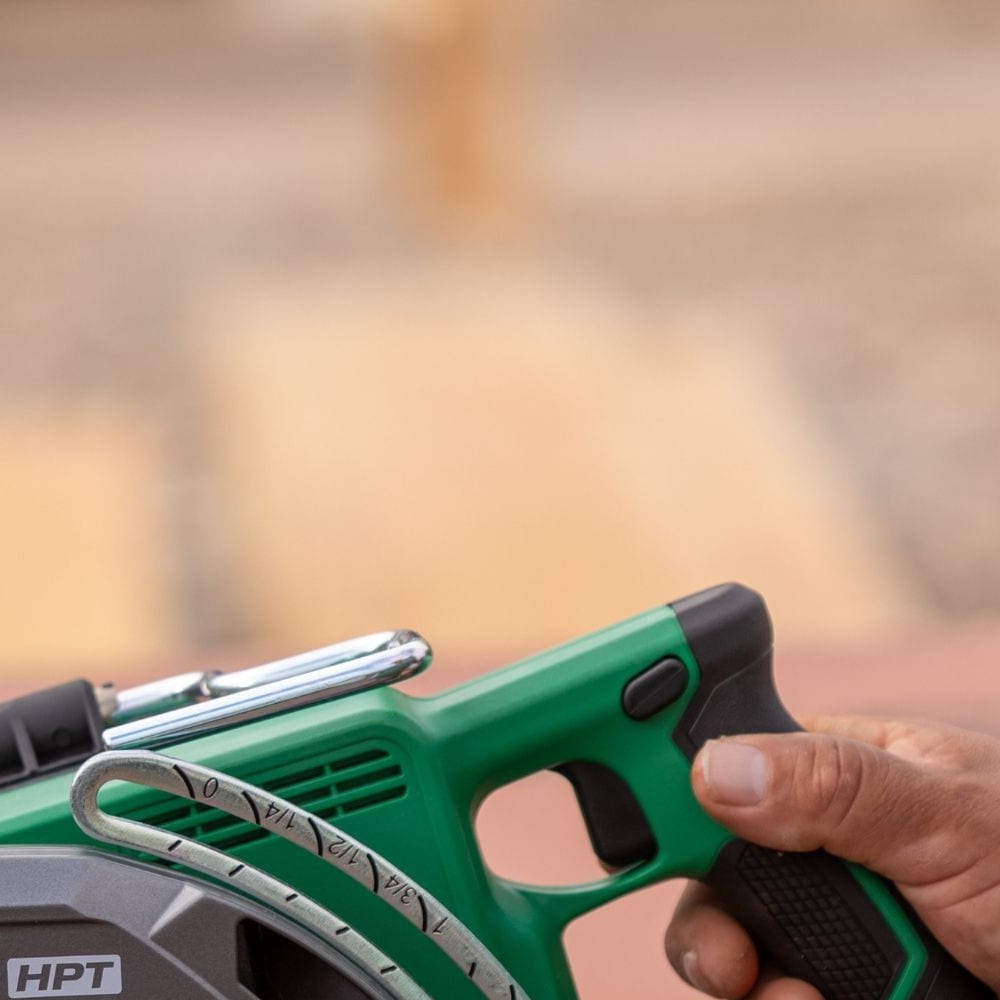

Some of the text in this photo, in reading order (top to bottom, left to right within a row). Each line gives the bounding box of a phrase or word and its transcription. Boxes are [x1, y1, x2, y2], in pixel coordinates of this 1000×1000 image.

[203, 777, 218, 798] 0
[265, 801, 296, 830] 1/4
[328, 835, 360, 865] 1/2
[384, 873, 416, 904] 3/4
[433, 916, 448, 933] 1
[12, 957, 118, 995] HPT
